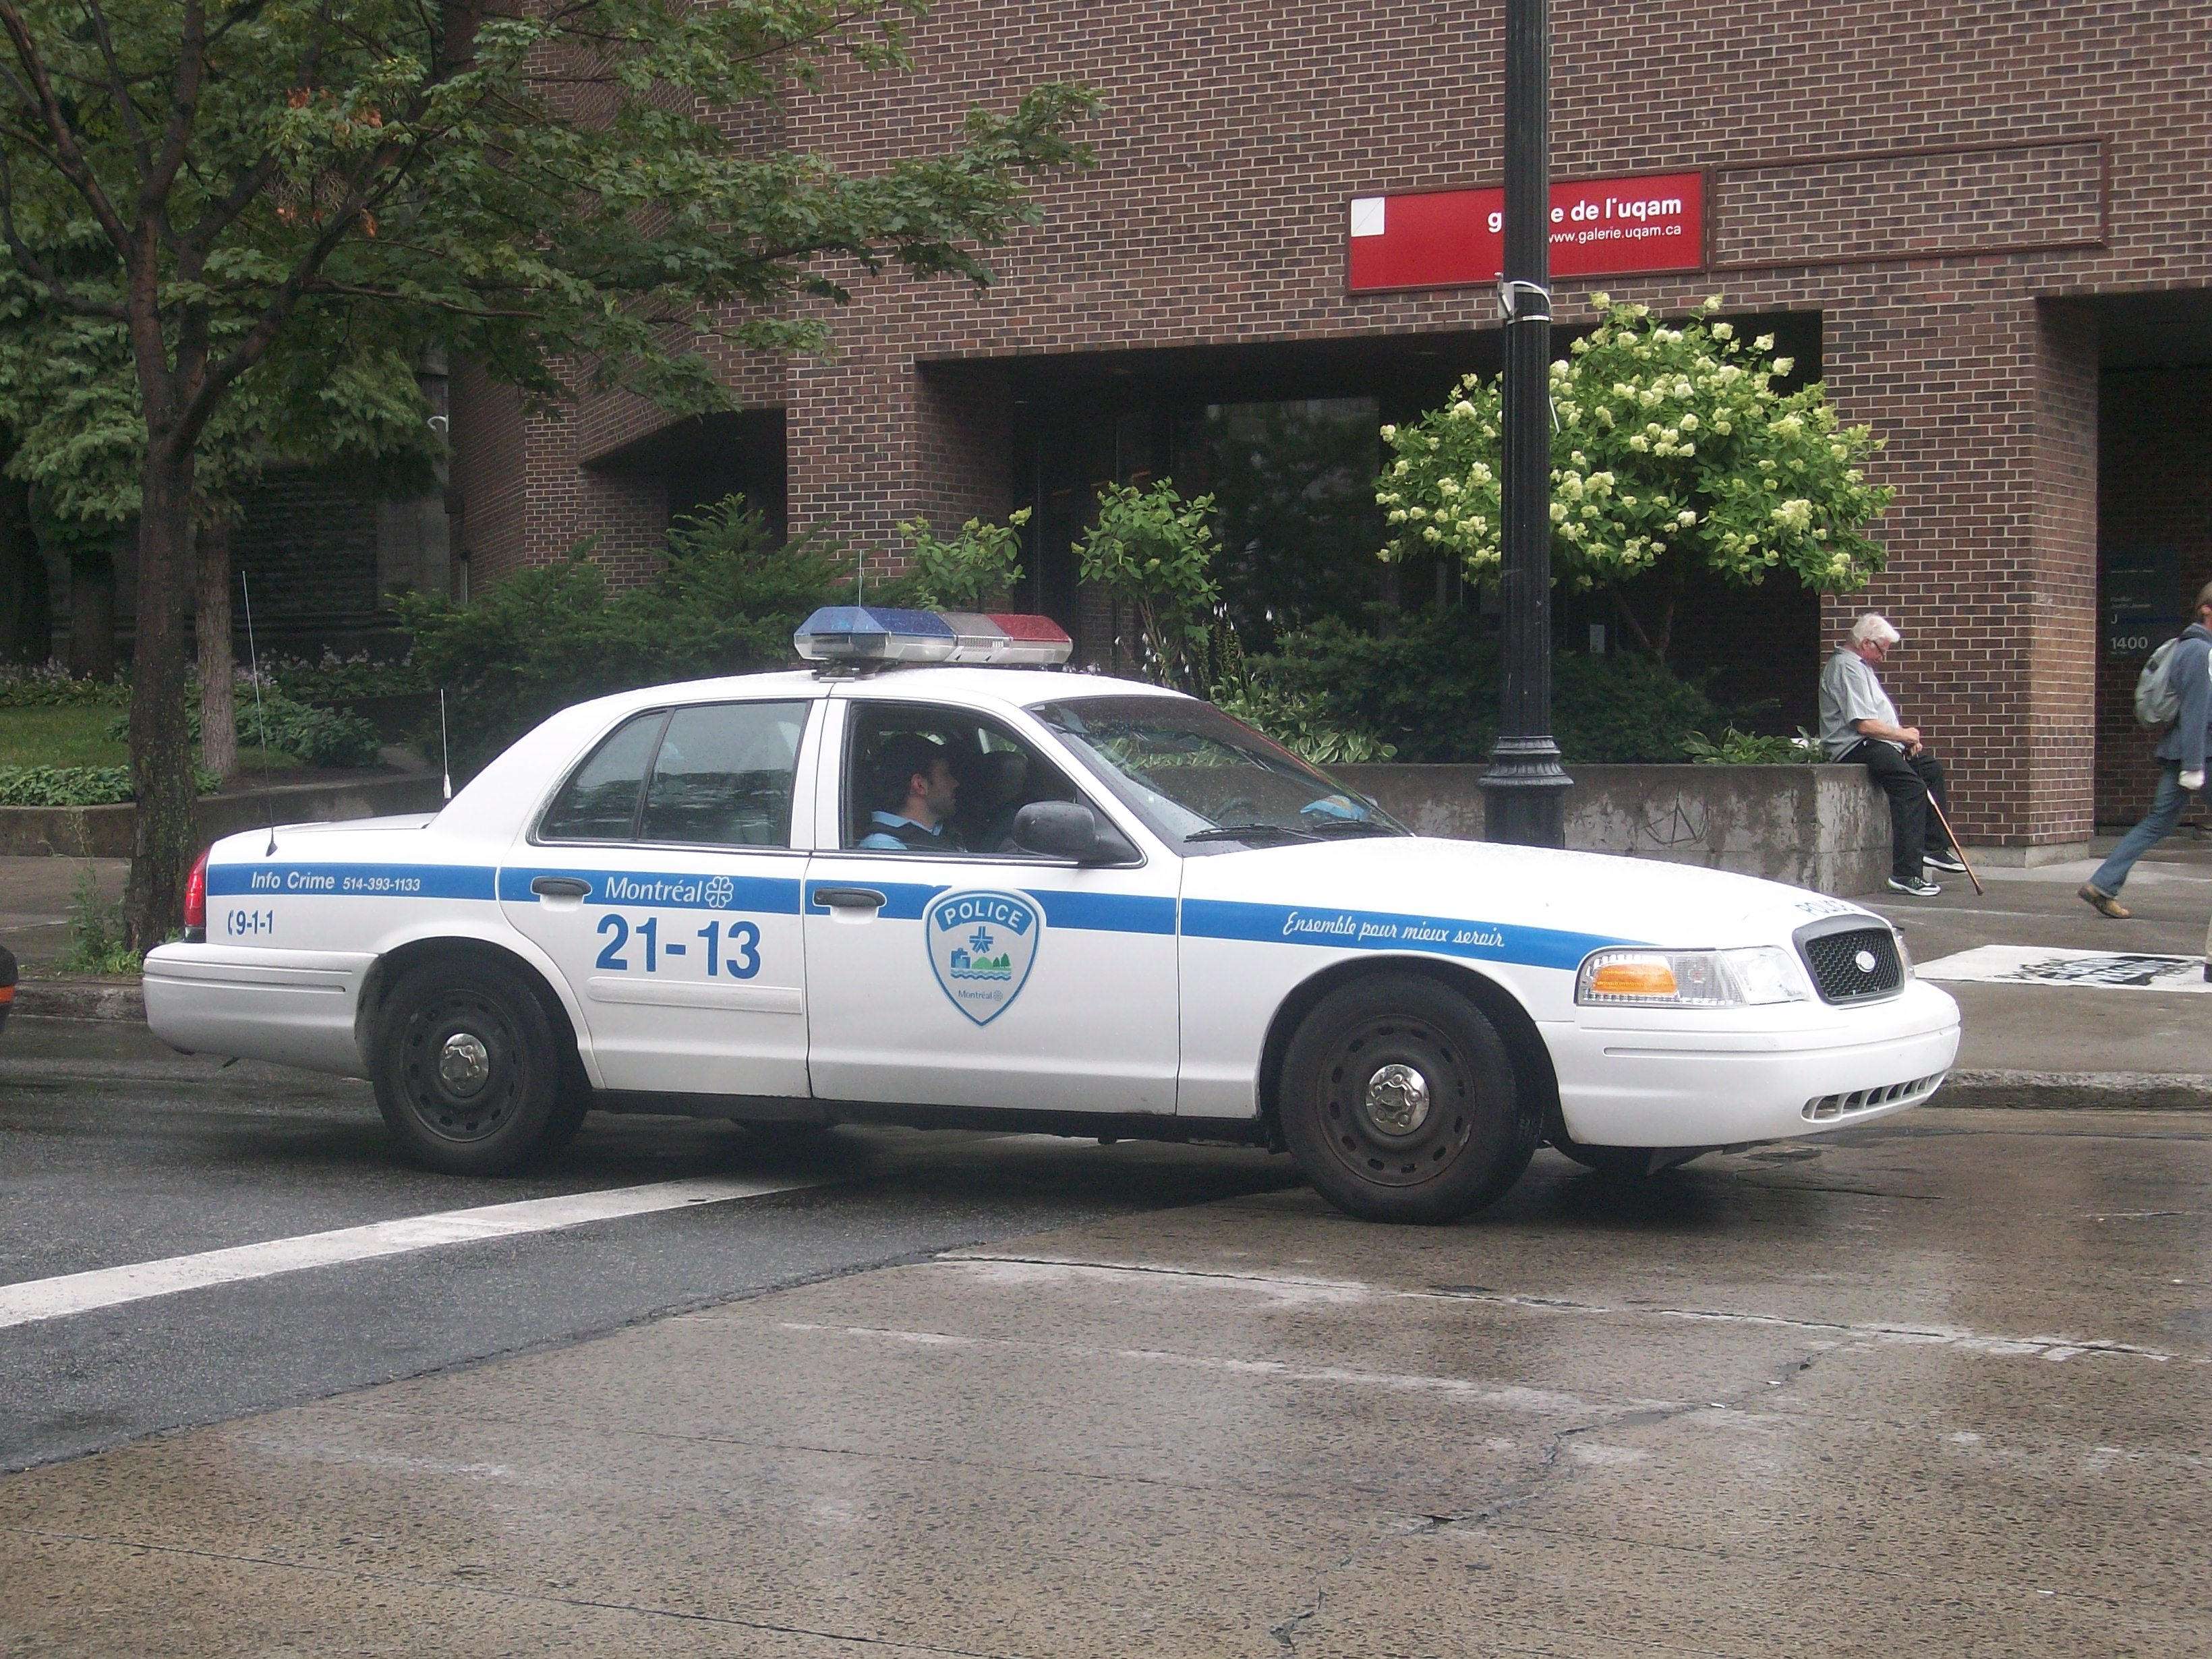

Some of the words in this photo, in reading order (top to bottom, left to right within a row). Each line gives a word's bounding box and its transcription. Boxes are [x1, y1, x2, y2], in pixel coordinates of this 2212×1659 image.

[1570, 200, 1599, 222] de
[1605, 198, 1681, 222] l'uqam
[2109, 637, 2149, 650] 1400
[251, 871, 281, 890] Info
[286, 872, 335, 890] Crime
[342, 877, 421, 891] 514-393-1133
[605, 876, 703, 903] Montréal
[944, 900, 1024, 929] POLICE
[1283, 912, 1357, 935] Ensemble
[1358, 921, 1397, 941] pour
[1401, 921, 1450, 942] mieux
[1452, 927, 1505, 948] servir
[595, 913, 762, 979] 21-13
[958, 989, 993, 1000] Montréal
